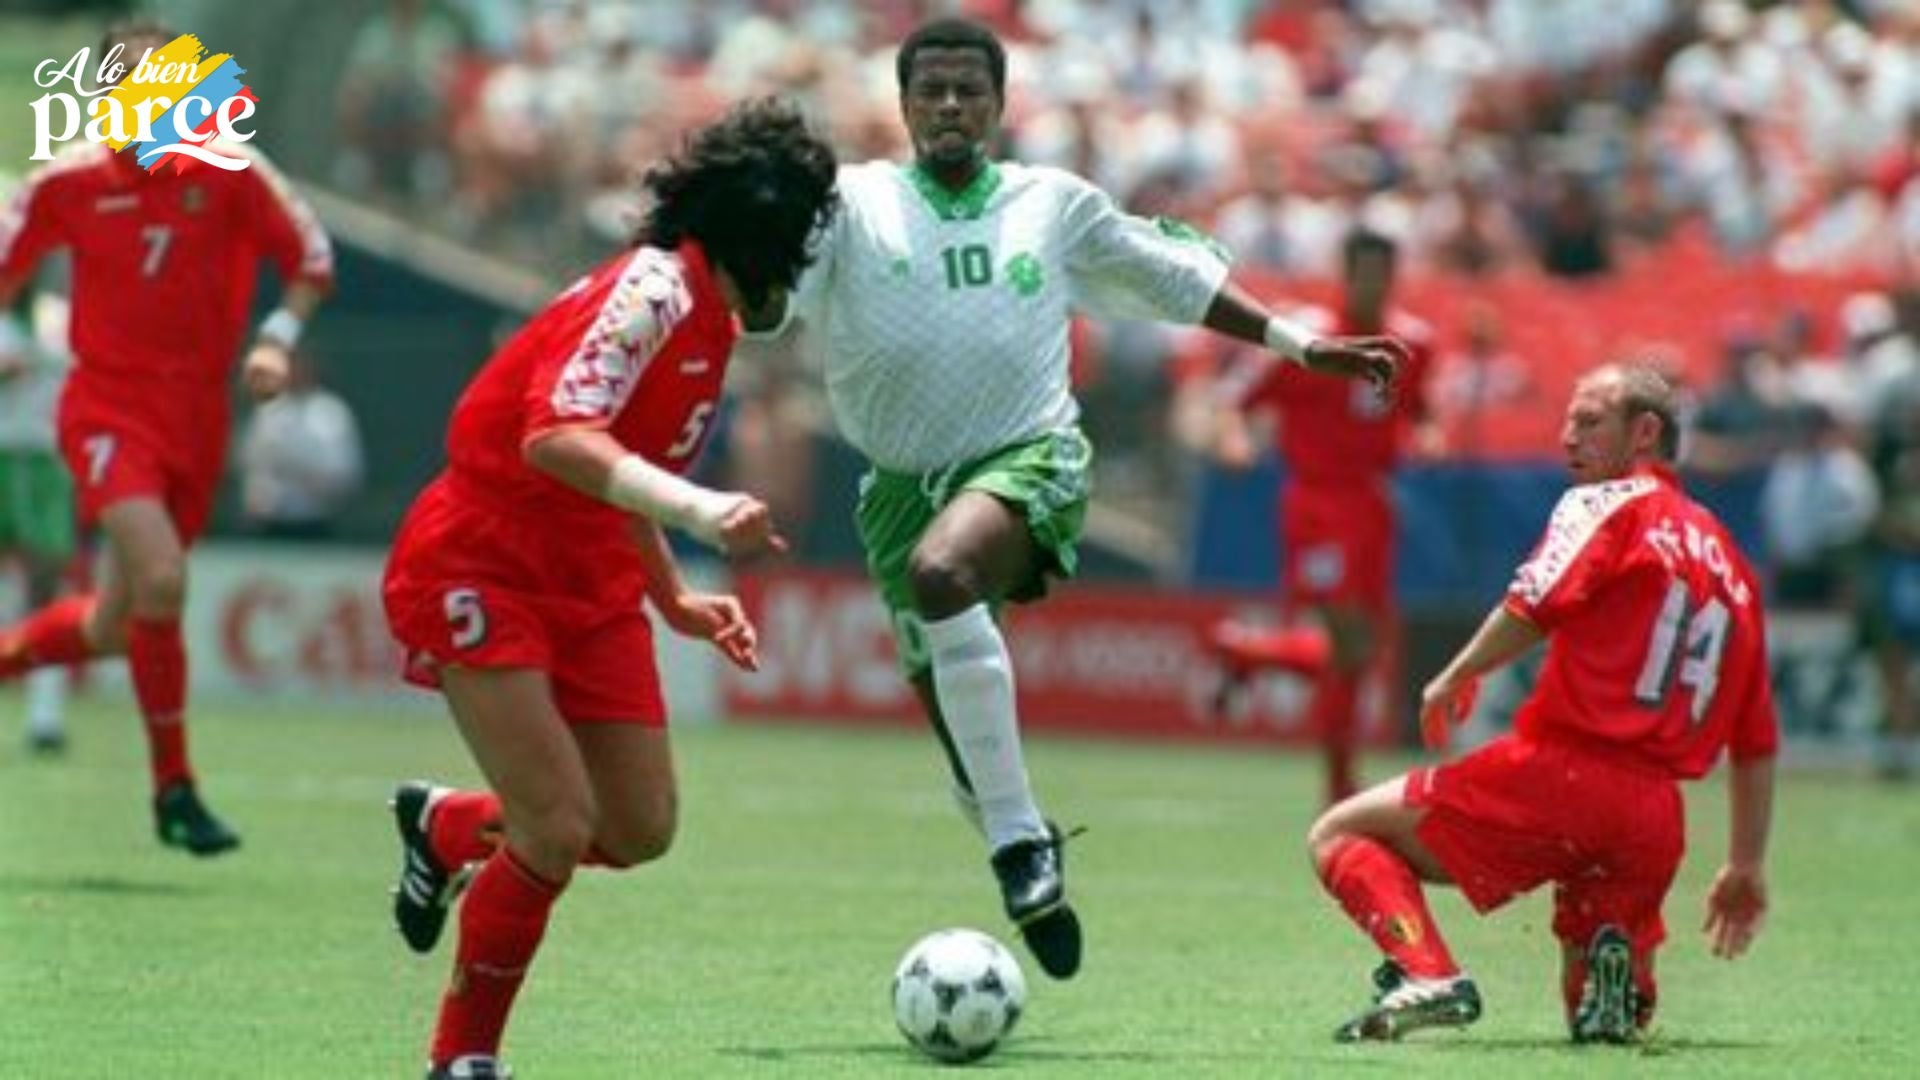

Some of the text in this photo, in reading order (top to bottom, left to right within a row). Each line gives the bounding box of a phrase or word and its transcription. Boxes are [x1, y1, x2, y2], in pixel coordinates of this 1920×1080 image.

[140, 225, 172, 277] 7
[941, 246, 992, 288] 10
[668, 402, 712, 458] 5
[83, 434, 116, 485] 7
[443, 588, 486, 648] 5
[1635, 576, 1730, 722] 14
